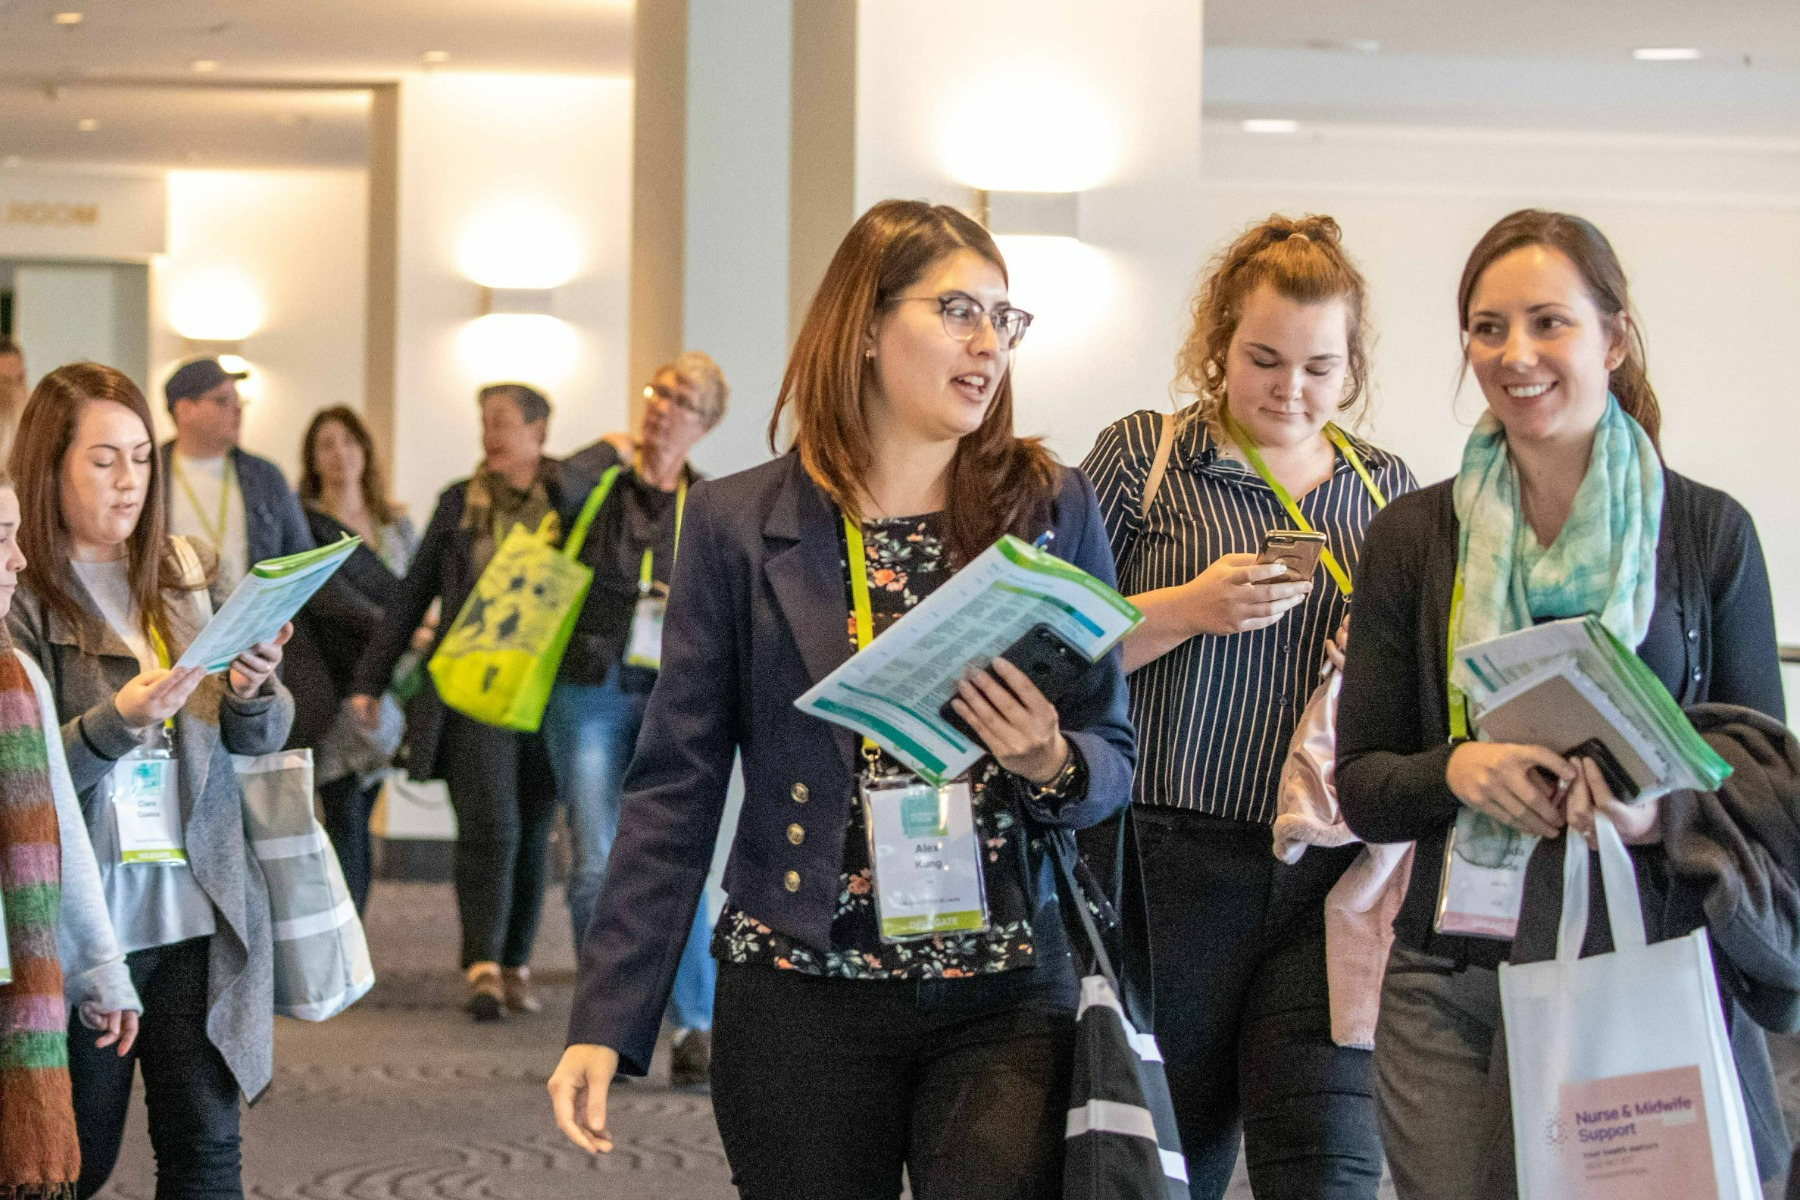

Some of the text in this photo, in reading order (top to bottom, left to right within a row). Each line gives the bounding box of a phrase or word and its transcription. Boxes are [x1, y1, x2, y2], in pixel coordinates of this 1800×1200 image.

[915, 843, 939, 854] Alex
[908, 916, 958, 930] DEGATE
[1576, 1097, 1692, 1124] Nurse & Midwife
[1579, 1123, 1636, 1142] Support
